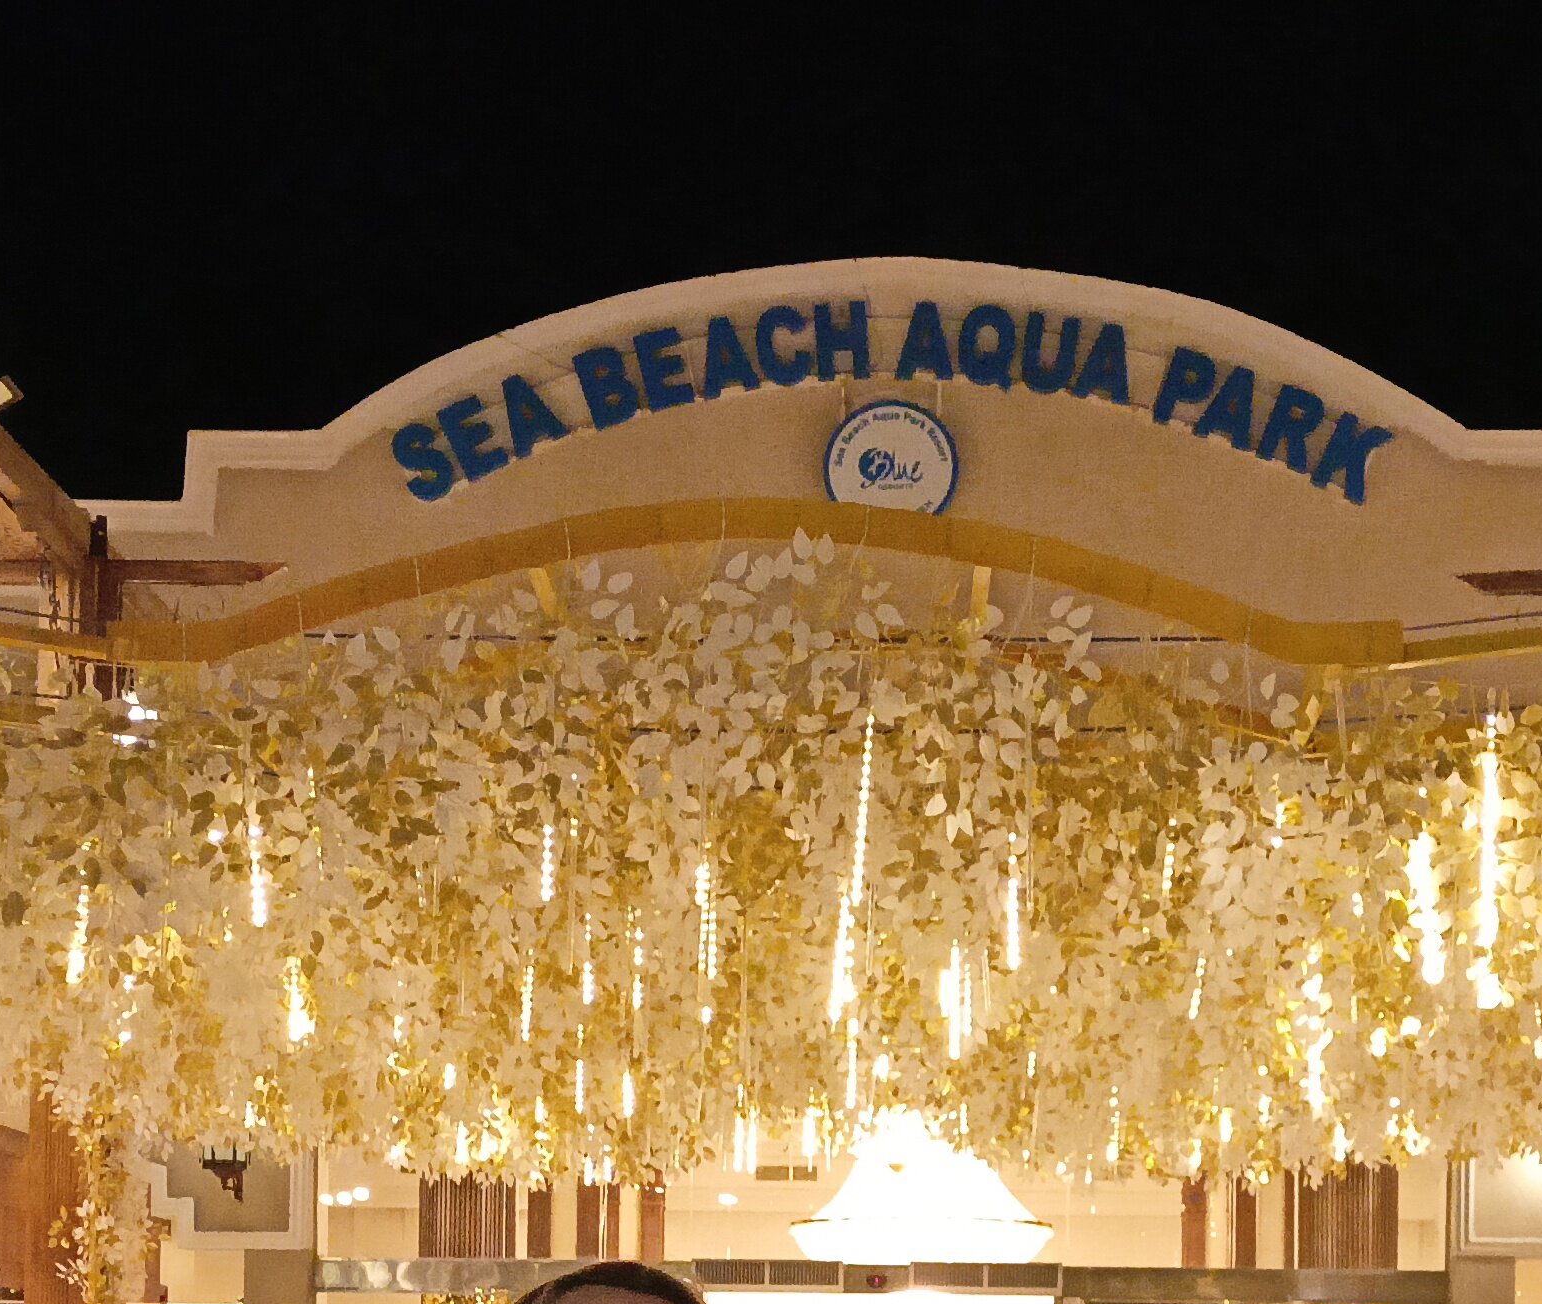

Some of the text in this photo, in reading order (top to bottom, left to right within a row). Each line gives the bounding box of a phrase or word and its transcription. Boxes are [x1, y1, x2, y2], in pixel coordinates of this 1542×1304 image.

[392, 301, 1392, 504] SEA BEACH AQUA PARK
[841, 418, 871, 445] Beach
[872, 411, 901, 422] Aqua
[904, 411, 926, 430] Park
